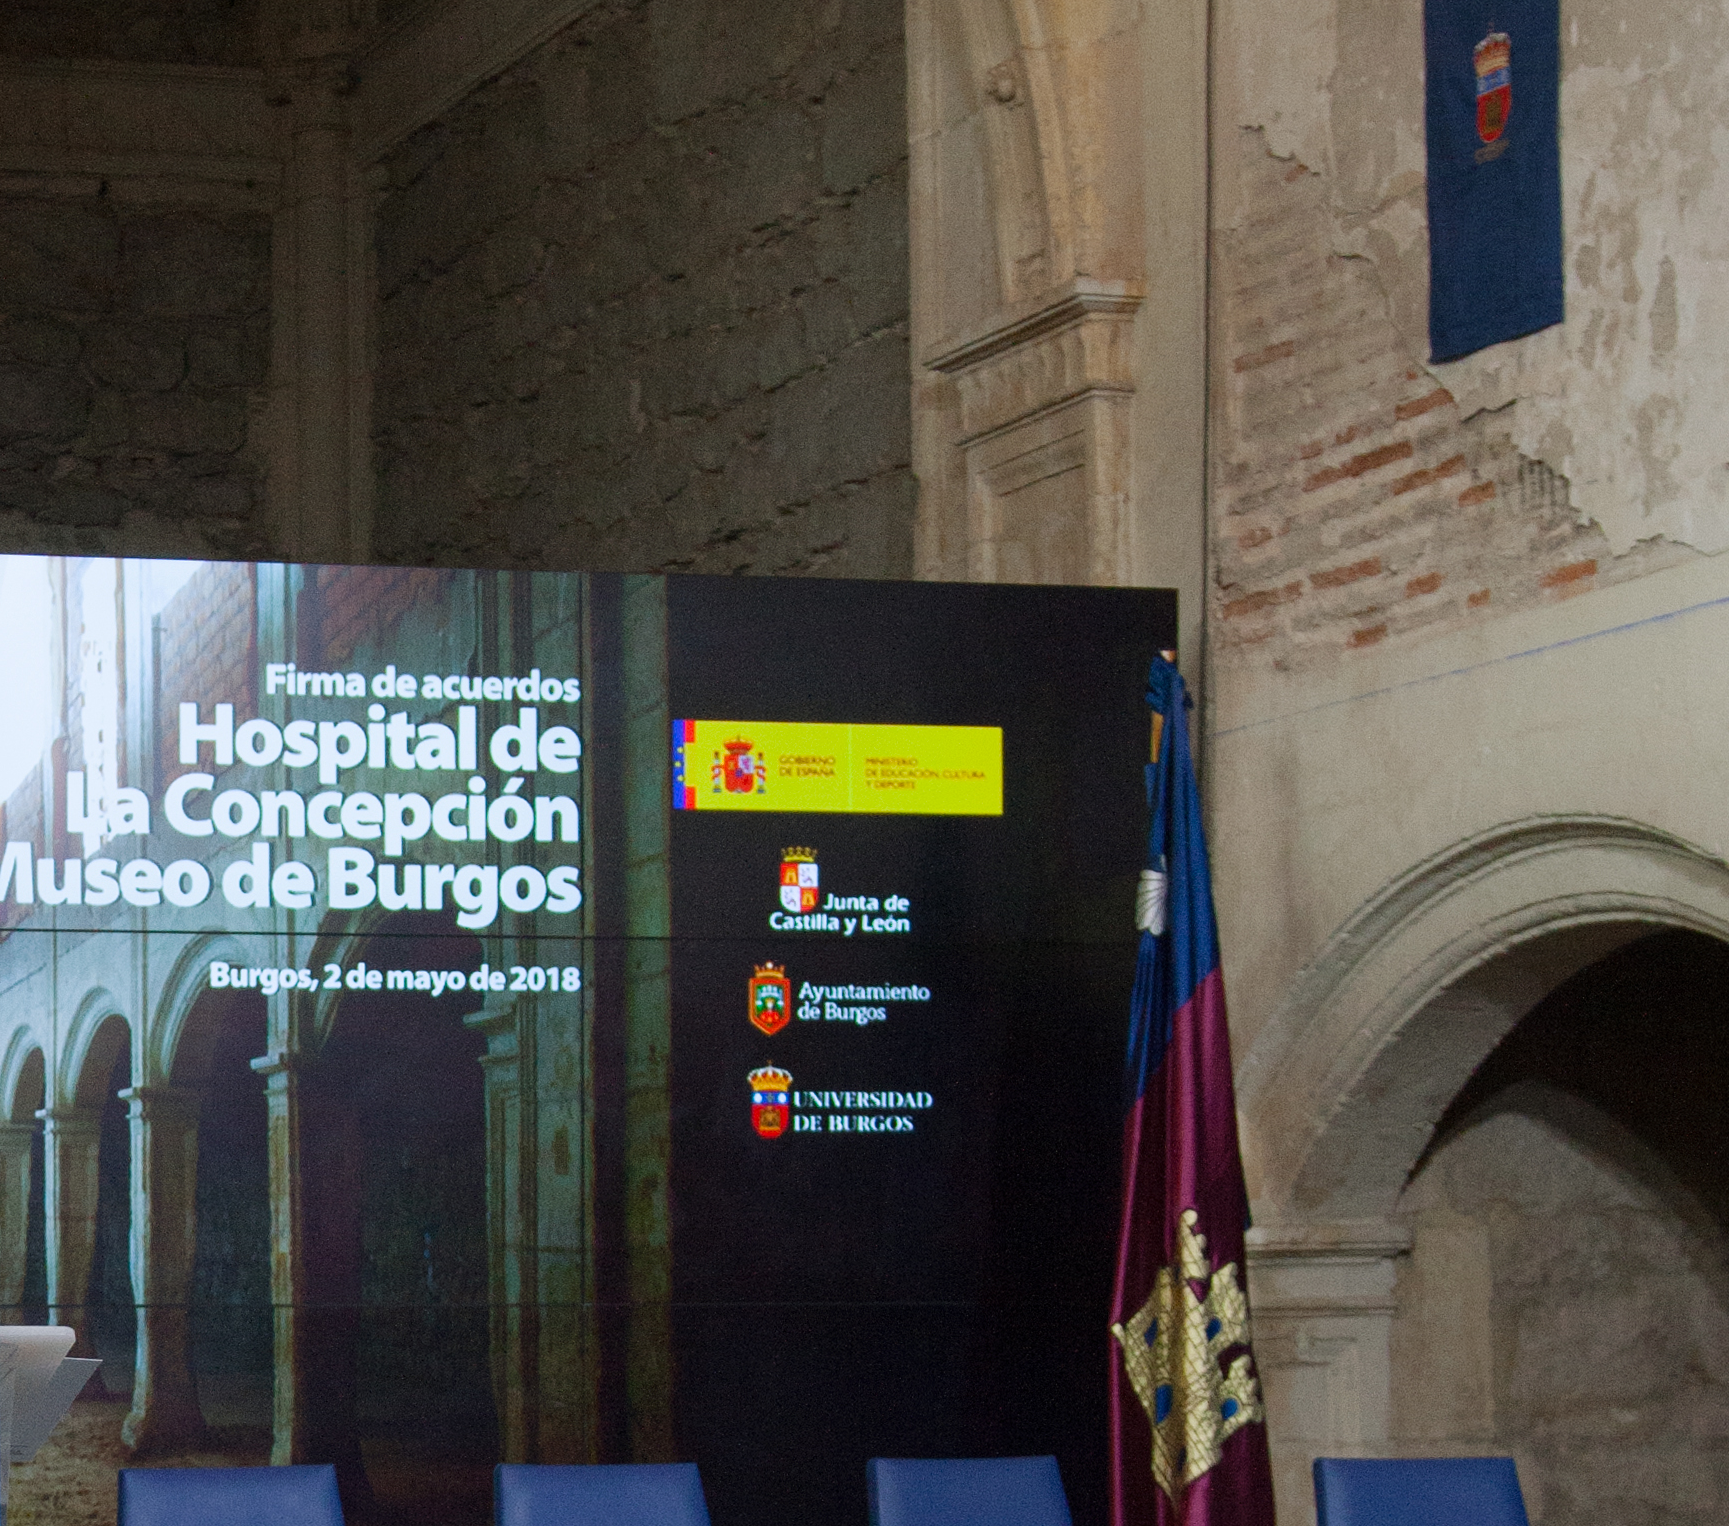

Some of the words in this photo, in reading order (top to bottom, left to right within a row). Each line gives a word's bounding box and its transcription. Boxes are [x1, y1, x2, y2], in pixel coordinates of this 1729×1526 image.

[266, 663, 367, 698] Firma
[372, 665, 417, 699] de
[422, 669, 580, 703] acuerdos
[179, 701, 478, 784] Hospital
[489, 709, 582, 773] de
[779, 755, 836, 765] GOBIERNO
[779, 767, 793, 777] DE
[797, 766, 835, 777] ESPAÑA
[67, 771, 150, 836] La
[165, 773, 580, 855] Concepción
[221, 844, 316, 910] de
[328, 848, 582, 929] Burgos
[823, 893, 879, 912] Junta
[884, 895, 910, 912] de
[769, 912, 840, 932] Castilla
[843, 916, 857, 936] y
[862, 914, 910, 932] León
[210, 963, 319, 993] Burgos,
[323, 963, 342, 989] 2
[347, 963, 382, 991] de
[387, 969, 464, 997] mayo
[470, 965, 505, 993] de
[509, 966, 581, 993] 2018
[798, 981, 931, 1002] Ayuntamiento
[797, 1002, 821, 1021] de
[825, 1003, 886, 1025] Burgos
[793, 1091, 933, 1108] UNIVERSIDAD
[793, 1115, 822, 1132] DE
[828, 1116, 913, 1132] BURGOS
